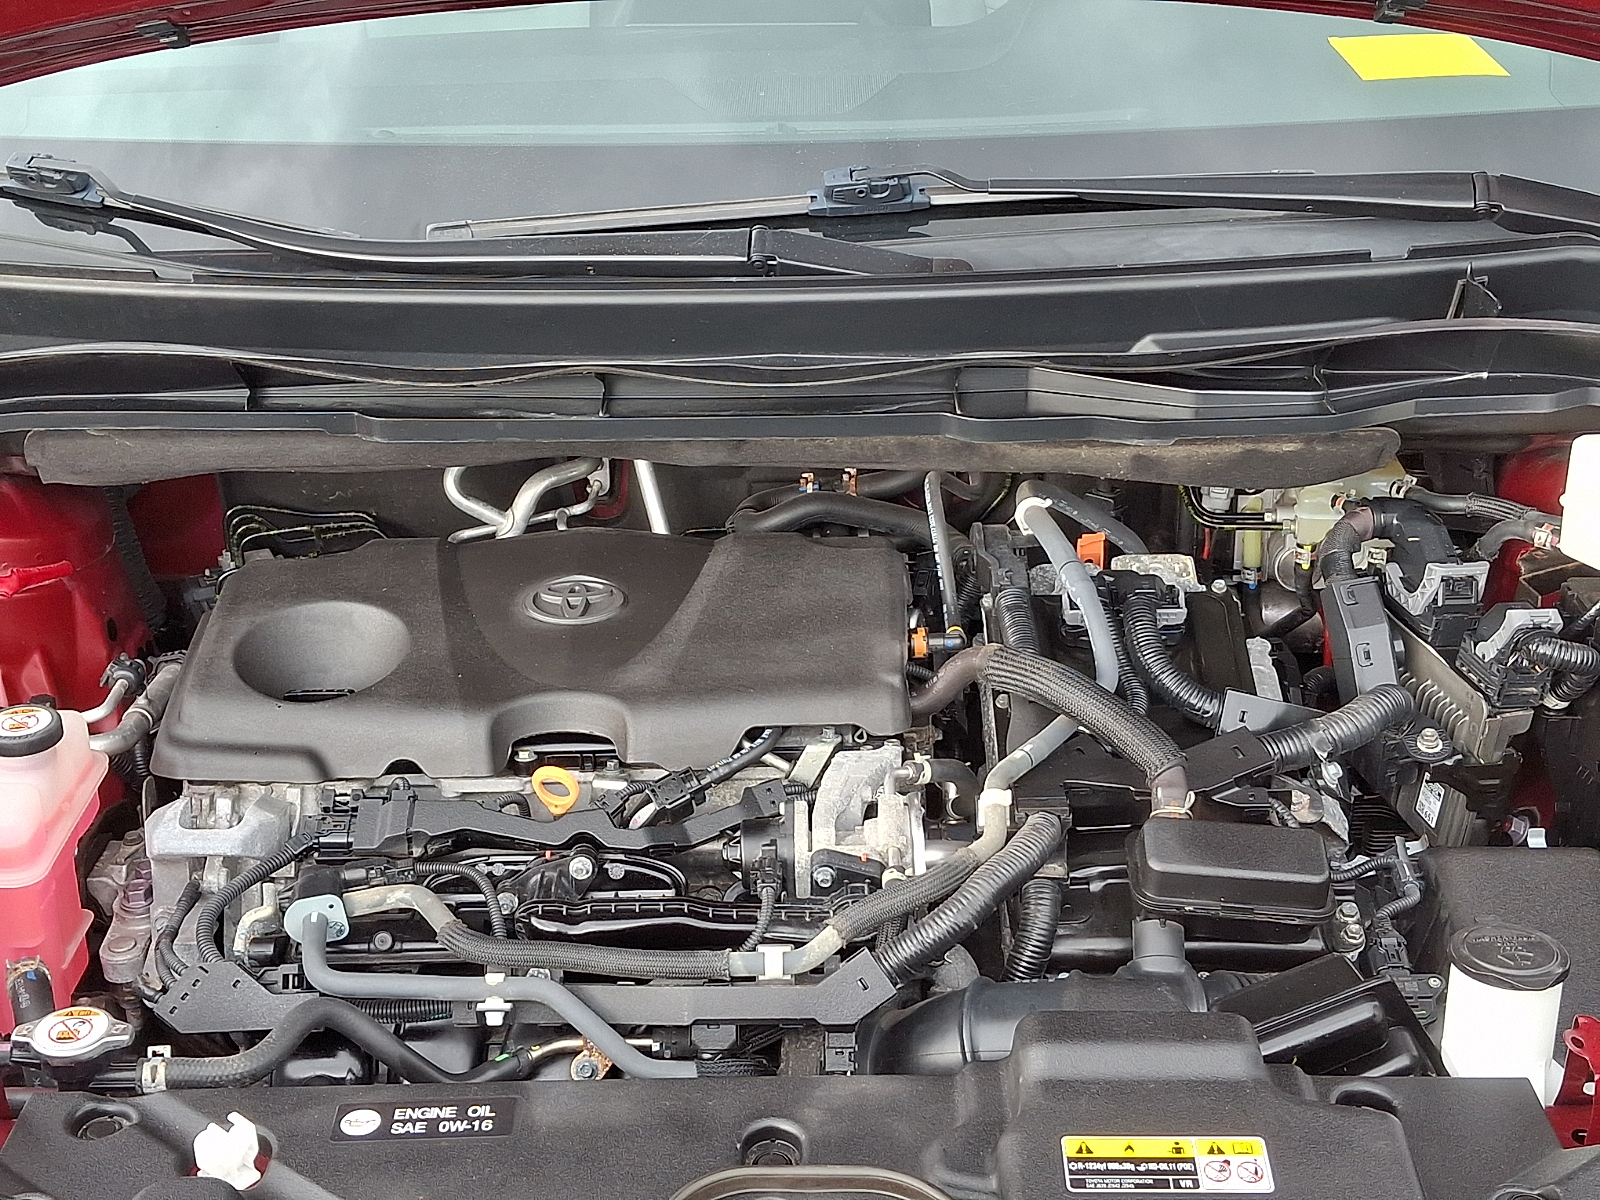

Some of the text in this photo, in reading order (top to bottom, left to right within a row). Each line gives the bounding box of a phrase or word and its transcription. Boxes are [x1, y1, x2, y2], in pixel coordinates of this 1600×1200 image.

[393, 1104, 496, 1120] ENGINE OIL
[390, 1119, 494, 1135] SAE 0W-16
